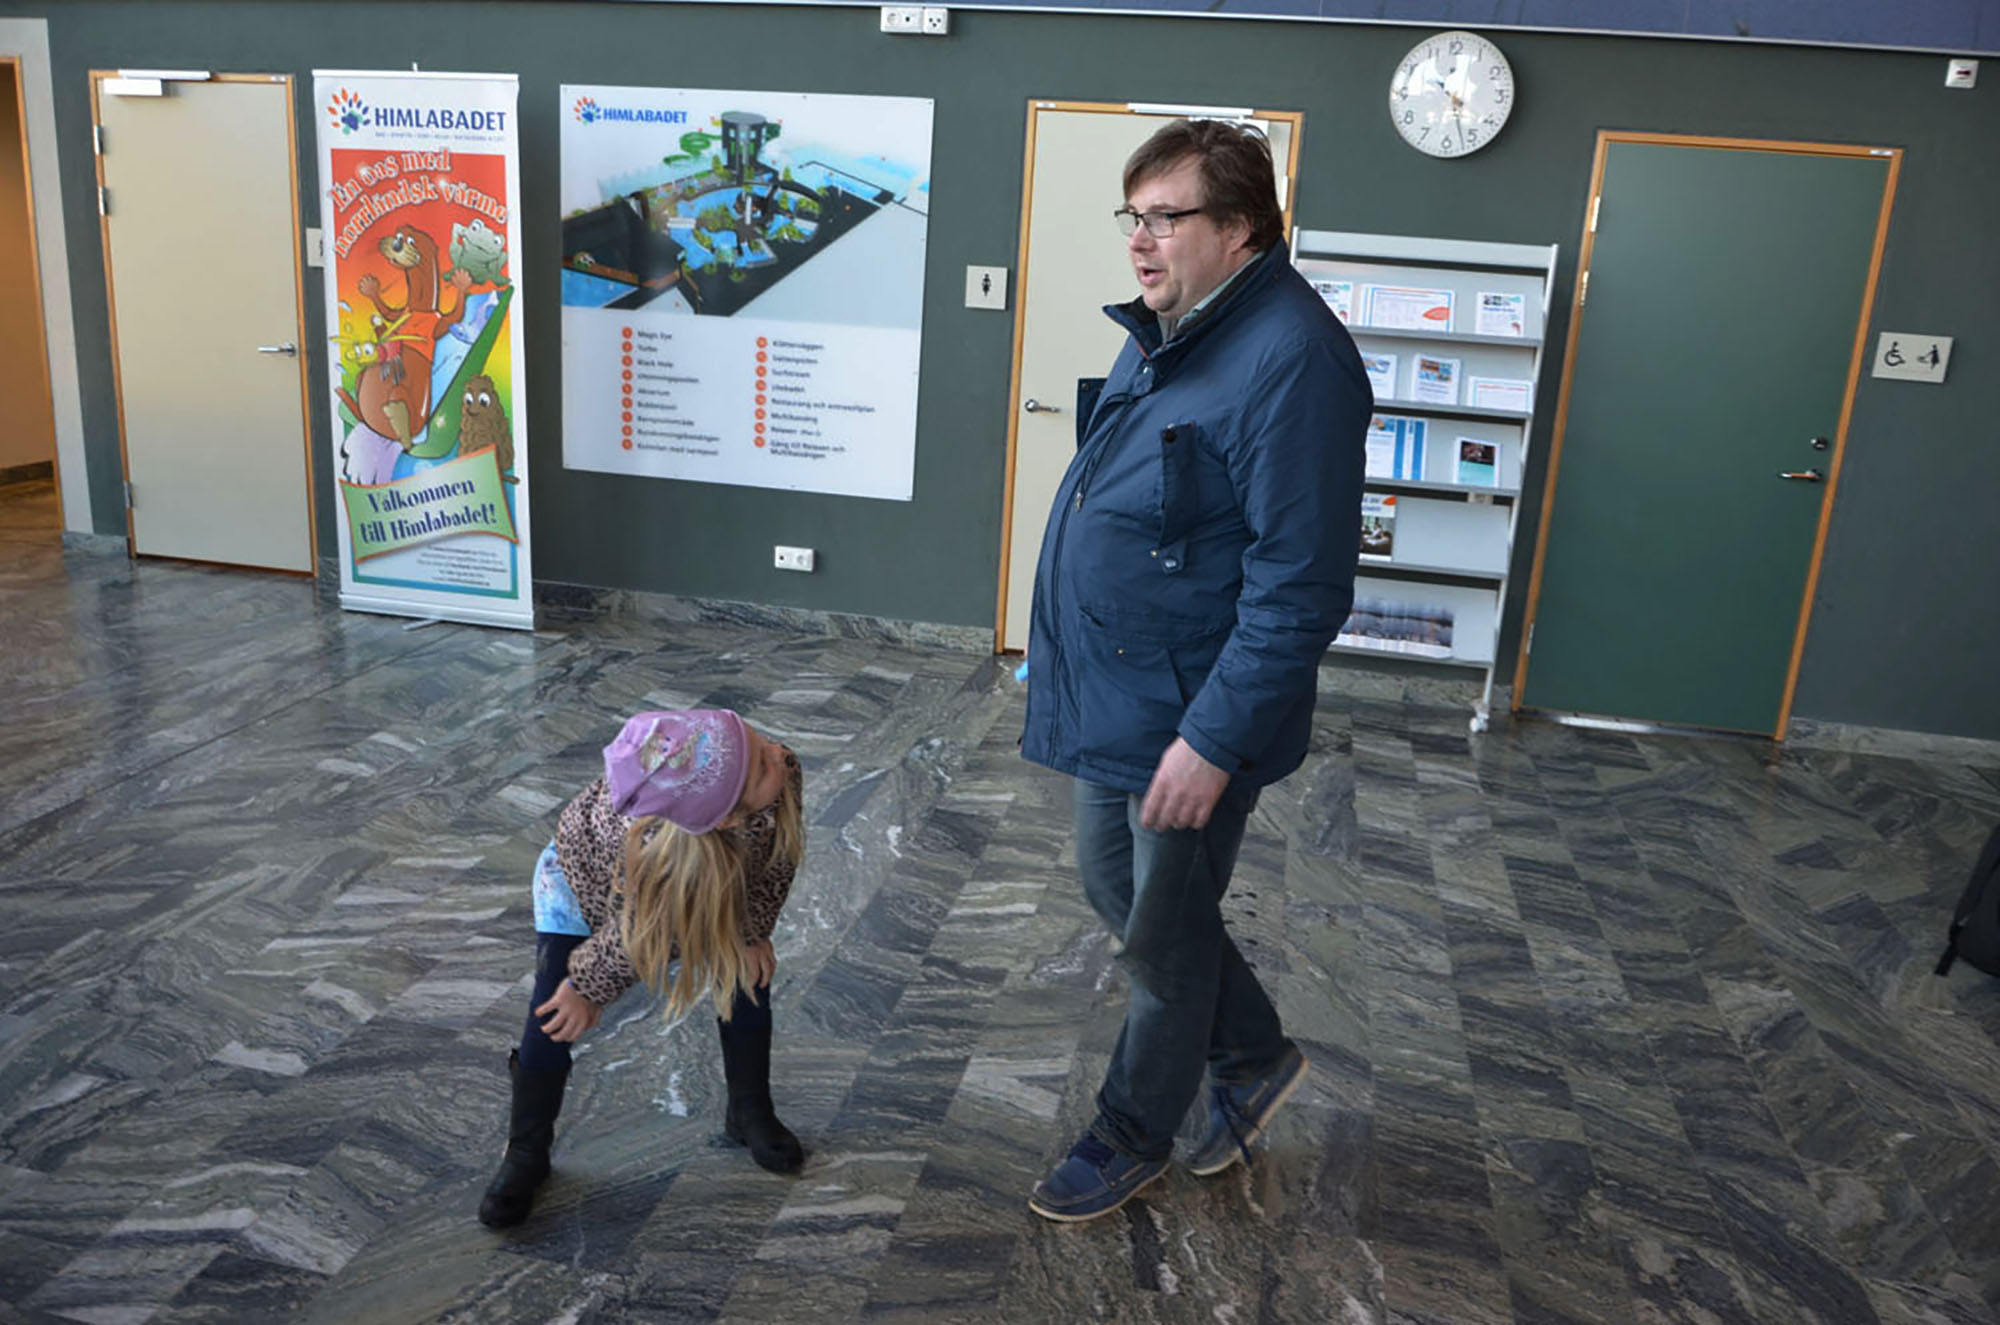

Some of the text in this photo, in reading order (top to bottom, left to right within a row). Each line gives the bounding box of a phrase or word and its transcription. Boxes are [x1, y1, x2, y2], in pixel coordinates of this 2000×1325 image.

[1449, 41, 1463, 55] 12
[1490, 66, 1501, 80] 2
[1495, 89, 1504, 104] 3
[374, 108, 507, 131] HIMLABADET
[603, 108, 688, 124] HIMLABADET
[1404, 110, 1414, 125] 8
[1420, 128, 1430, 140] 7
[1467, 129, 1478, 143] 5
[1441, 135, 1452, 149] 6
[401, 147, 451, 172] med
[368, 479, 476, 513] Välkommen
[359, 503, 498, 544] till Himlabadet!
